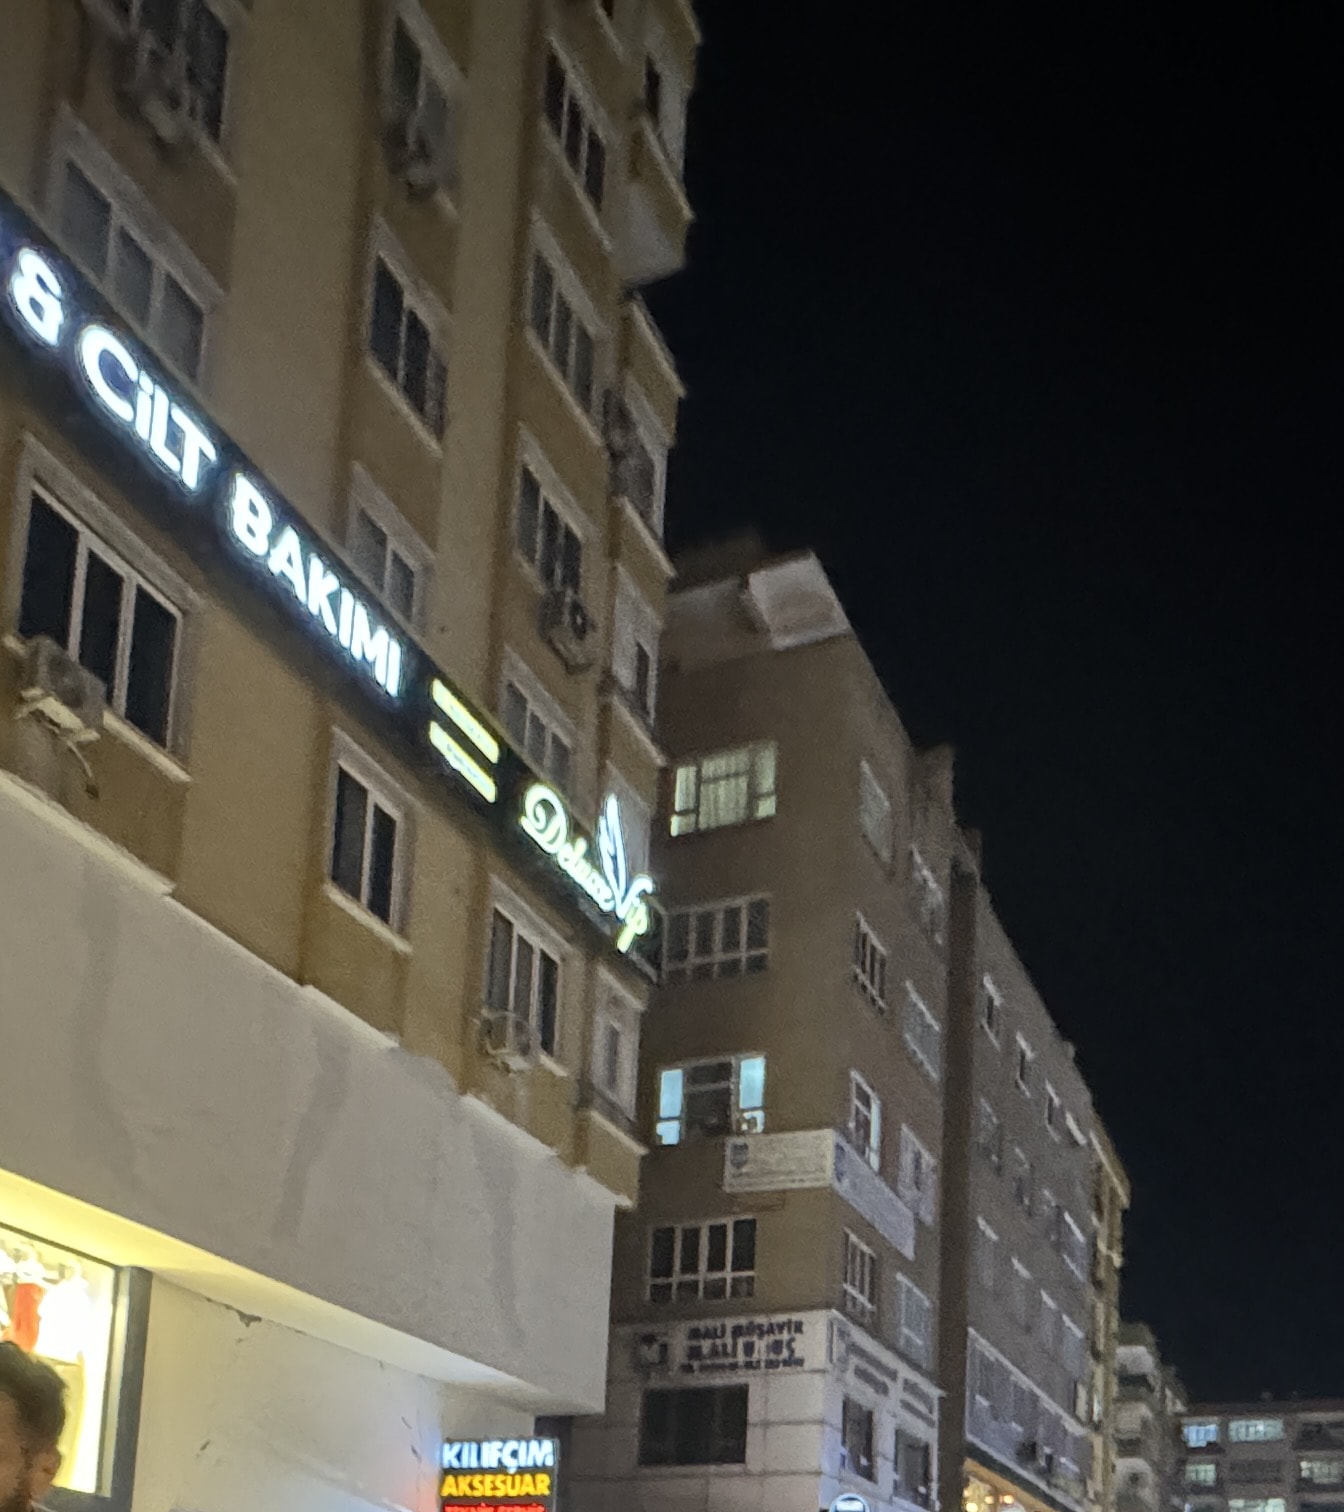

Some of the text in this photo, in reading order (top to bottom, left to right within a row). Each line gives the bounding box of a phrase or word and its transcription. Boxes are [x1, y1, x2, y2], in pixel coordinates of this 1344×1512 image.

[12, 248, 65, 346] &
[229, 473, 402, 698] BAKIMI
[440, 1473, 552, 1497] AKSESUAR
